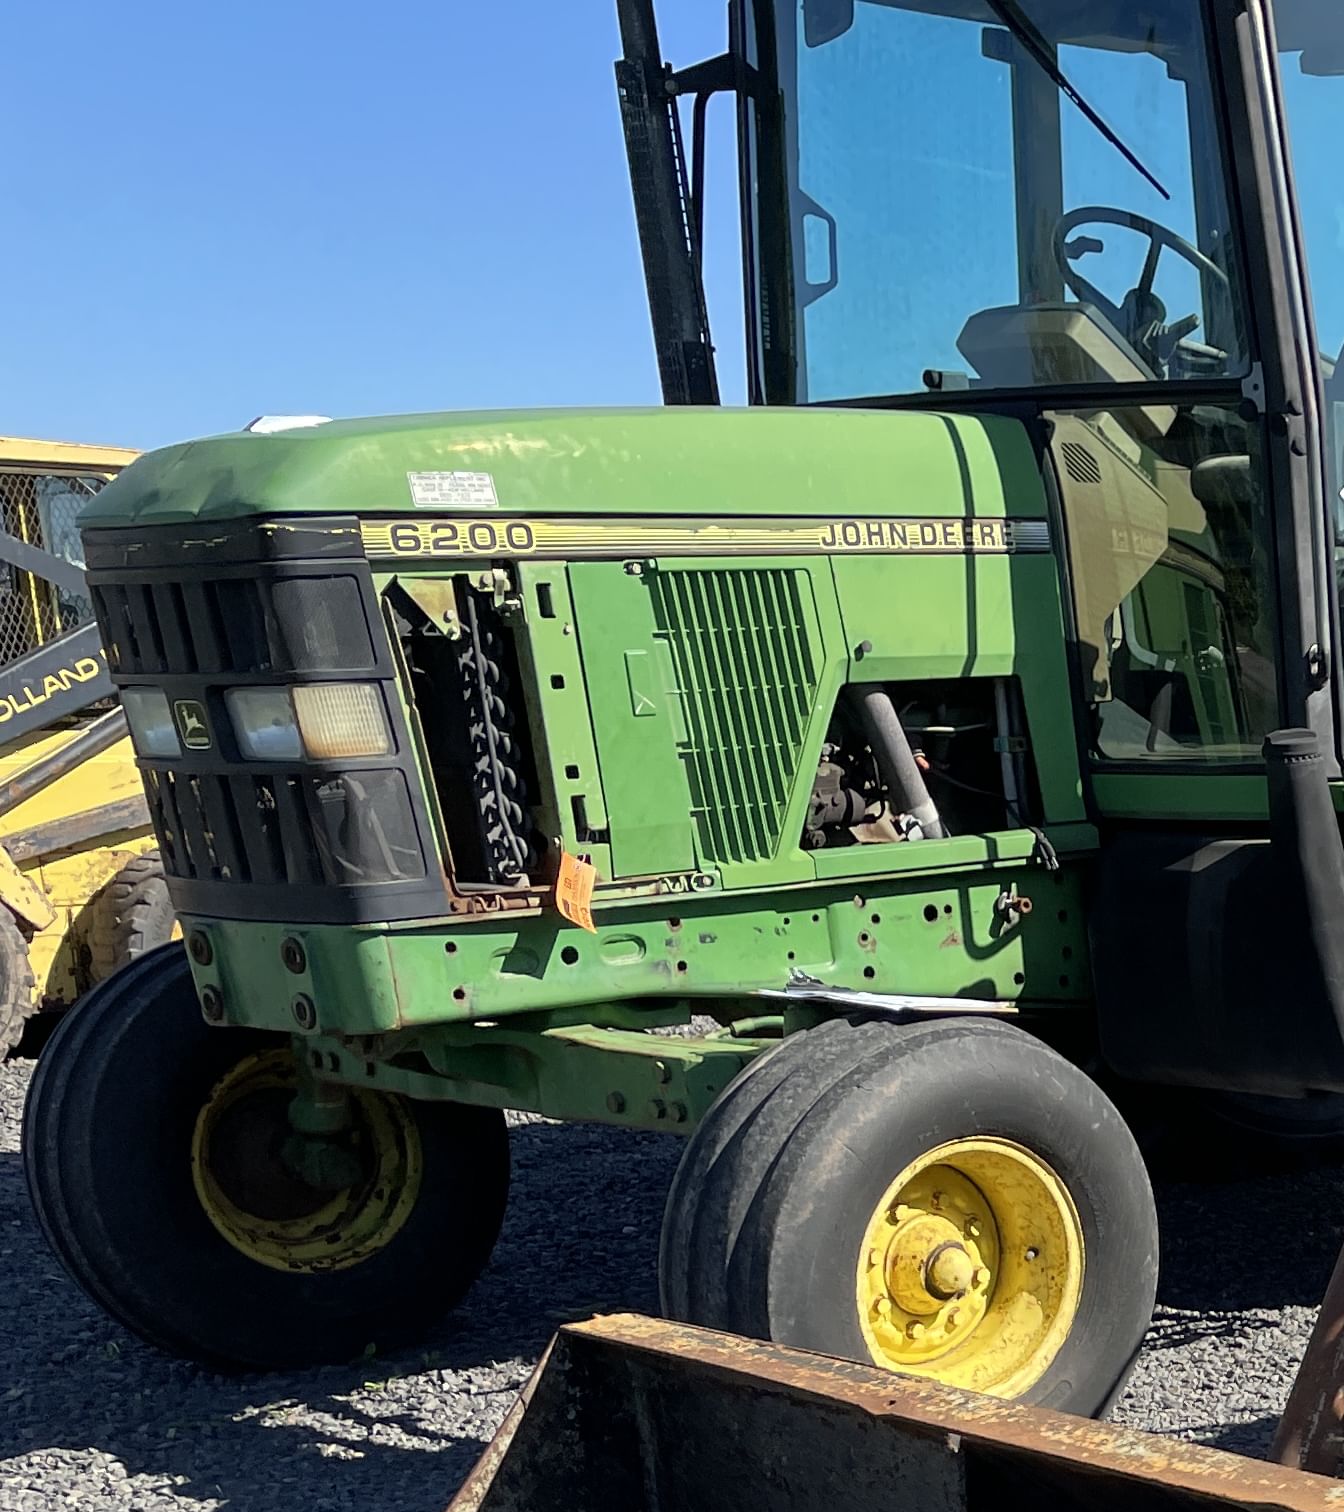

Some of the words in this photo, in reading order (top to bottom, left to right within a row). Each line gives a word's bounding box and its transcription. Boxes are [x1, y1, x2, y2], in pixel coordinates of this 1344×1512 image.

[389, 522, 534, 552] 6200
[821, 521, 909, 547] JOHN
[919, 522, 1017, 548] DEERE
